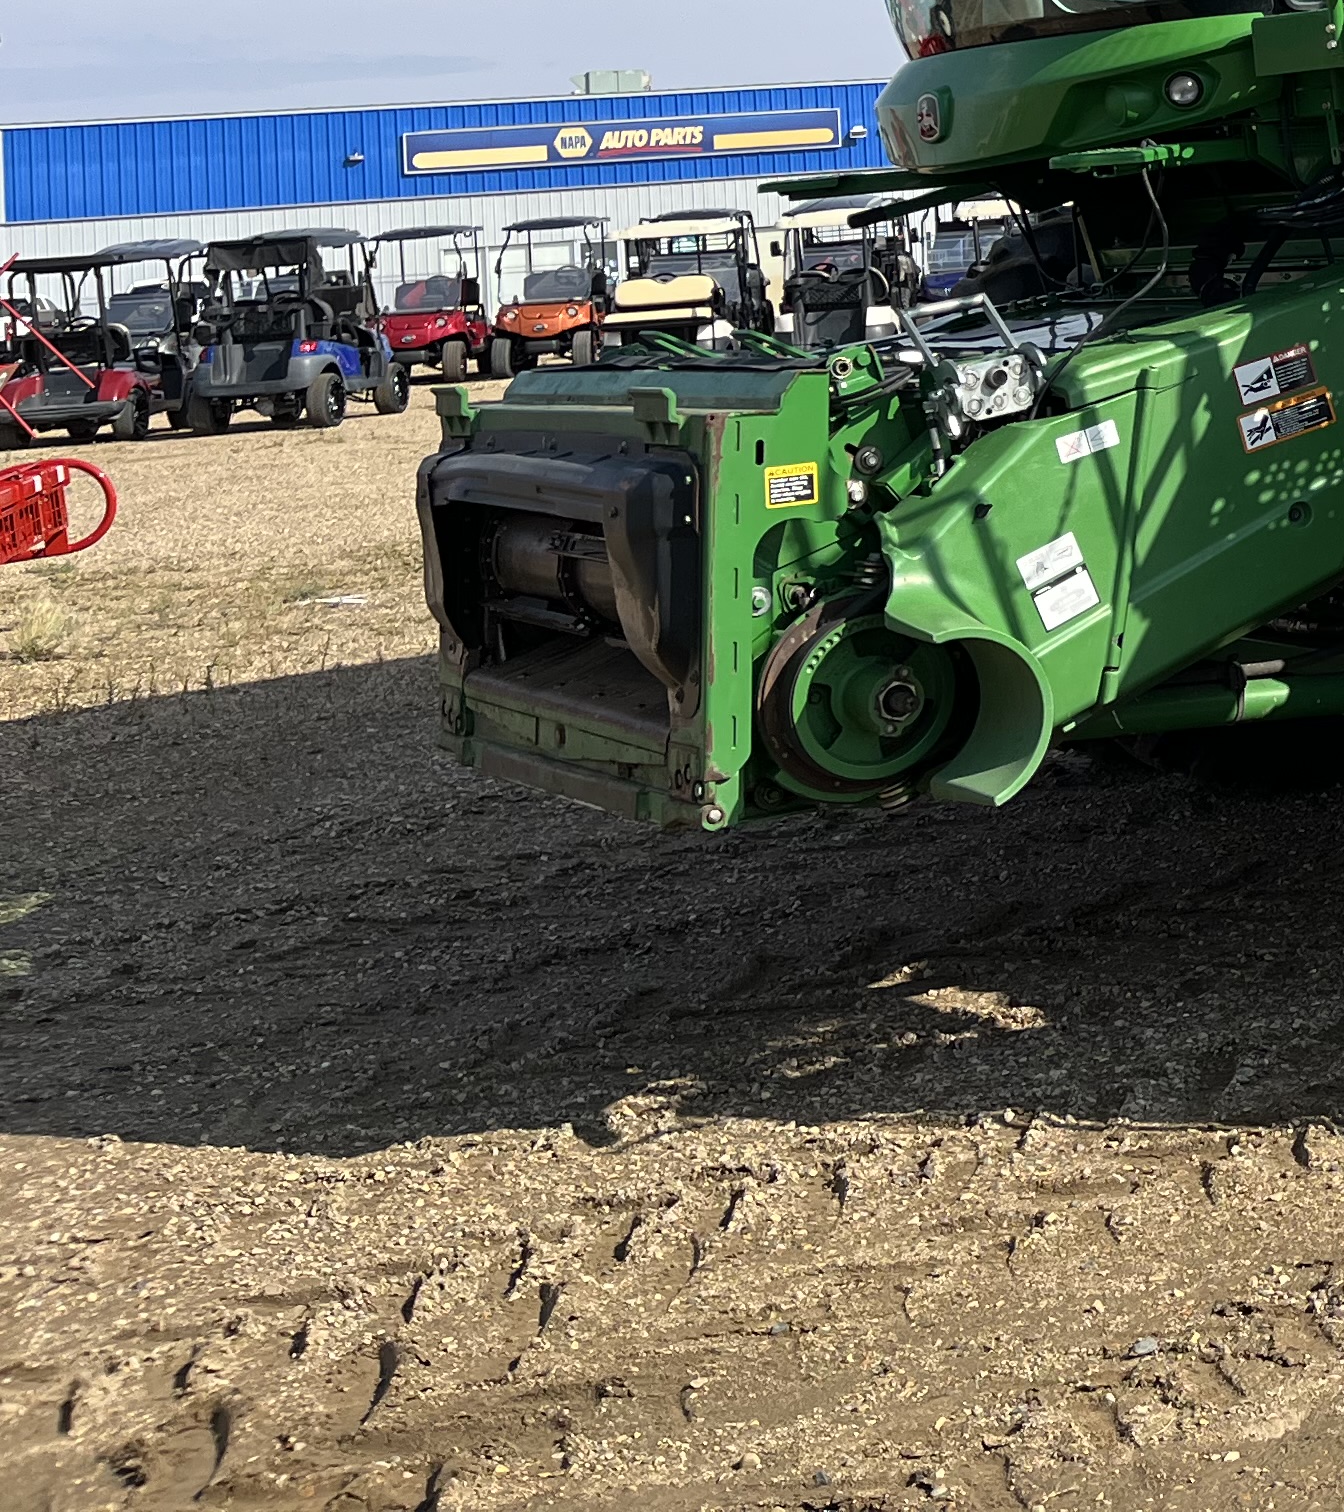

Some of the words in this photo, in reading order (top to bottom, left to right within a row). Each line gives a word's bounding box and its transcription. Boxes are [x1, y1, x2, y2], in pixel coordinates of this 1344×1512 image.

[560, 135, 587, 150] NAPA
[599, 129, 649, 150] AUTO
[650, 126, 704, 147] PARTS
[774, 465, 814, 476] CAUTION
